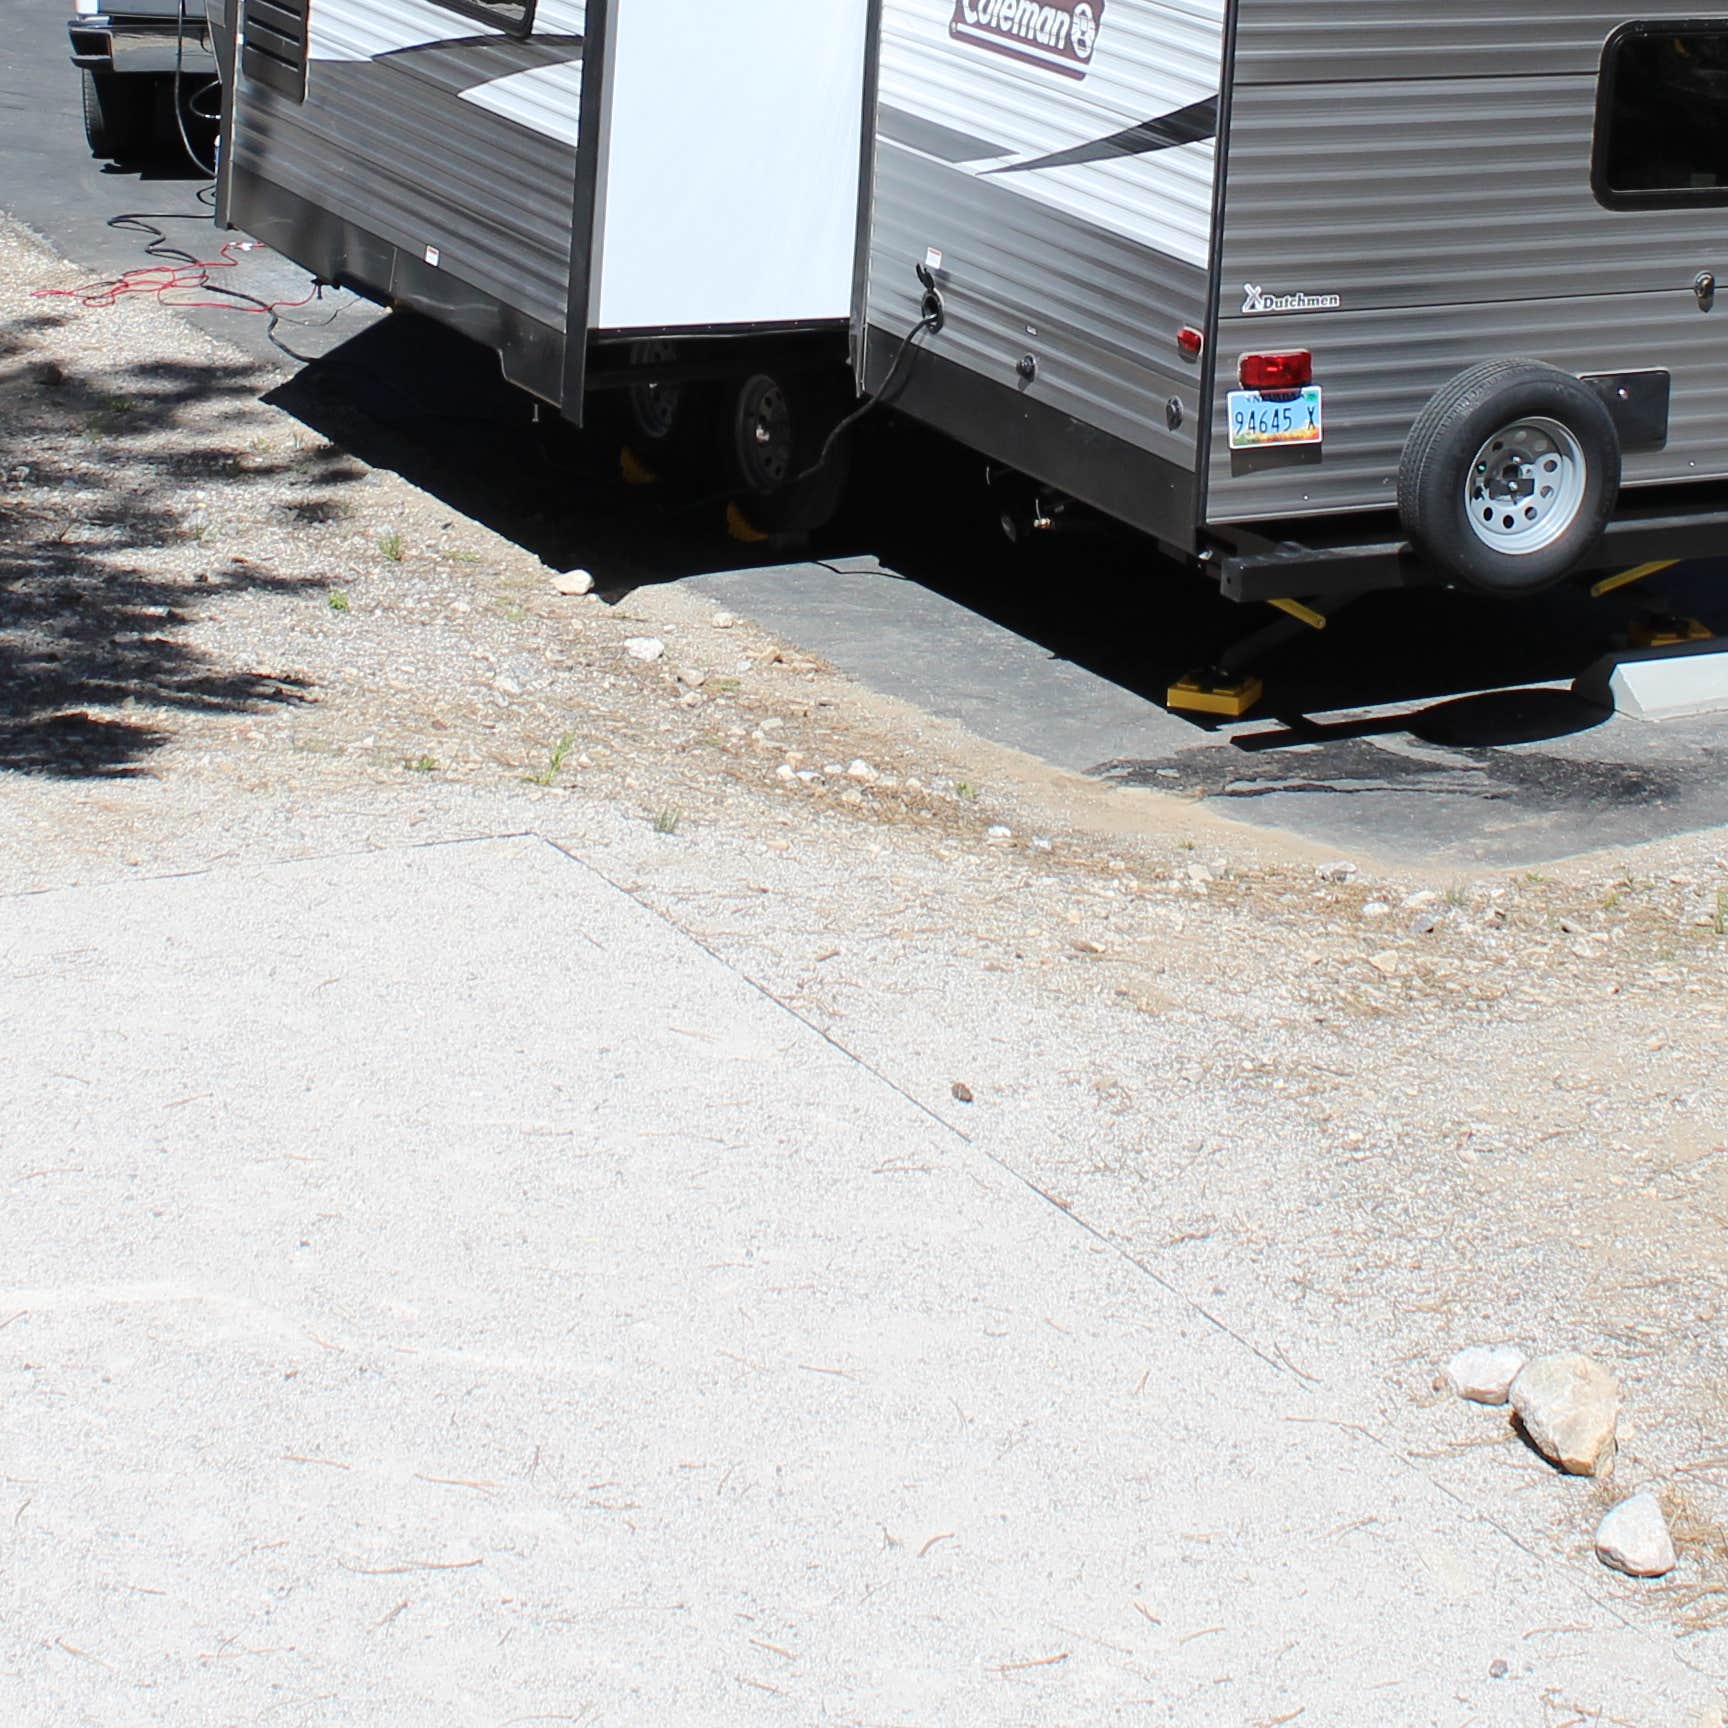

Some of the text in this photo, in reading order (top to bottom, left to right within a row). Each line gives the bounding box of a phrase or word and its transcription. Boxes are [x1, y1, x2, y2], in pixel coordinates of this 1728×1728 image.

[1263, 293, 1338, 309] Dutchmen
[1235, 406, 1316, 435] 94645 X
